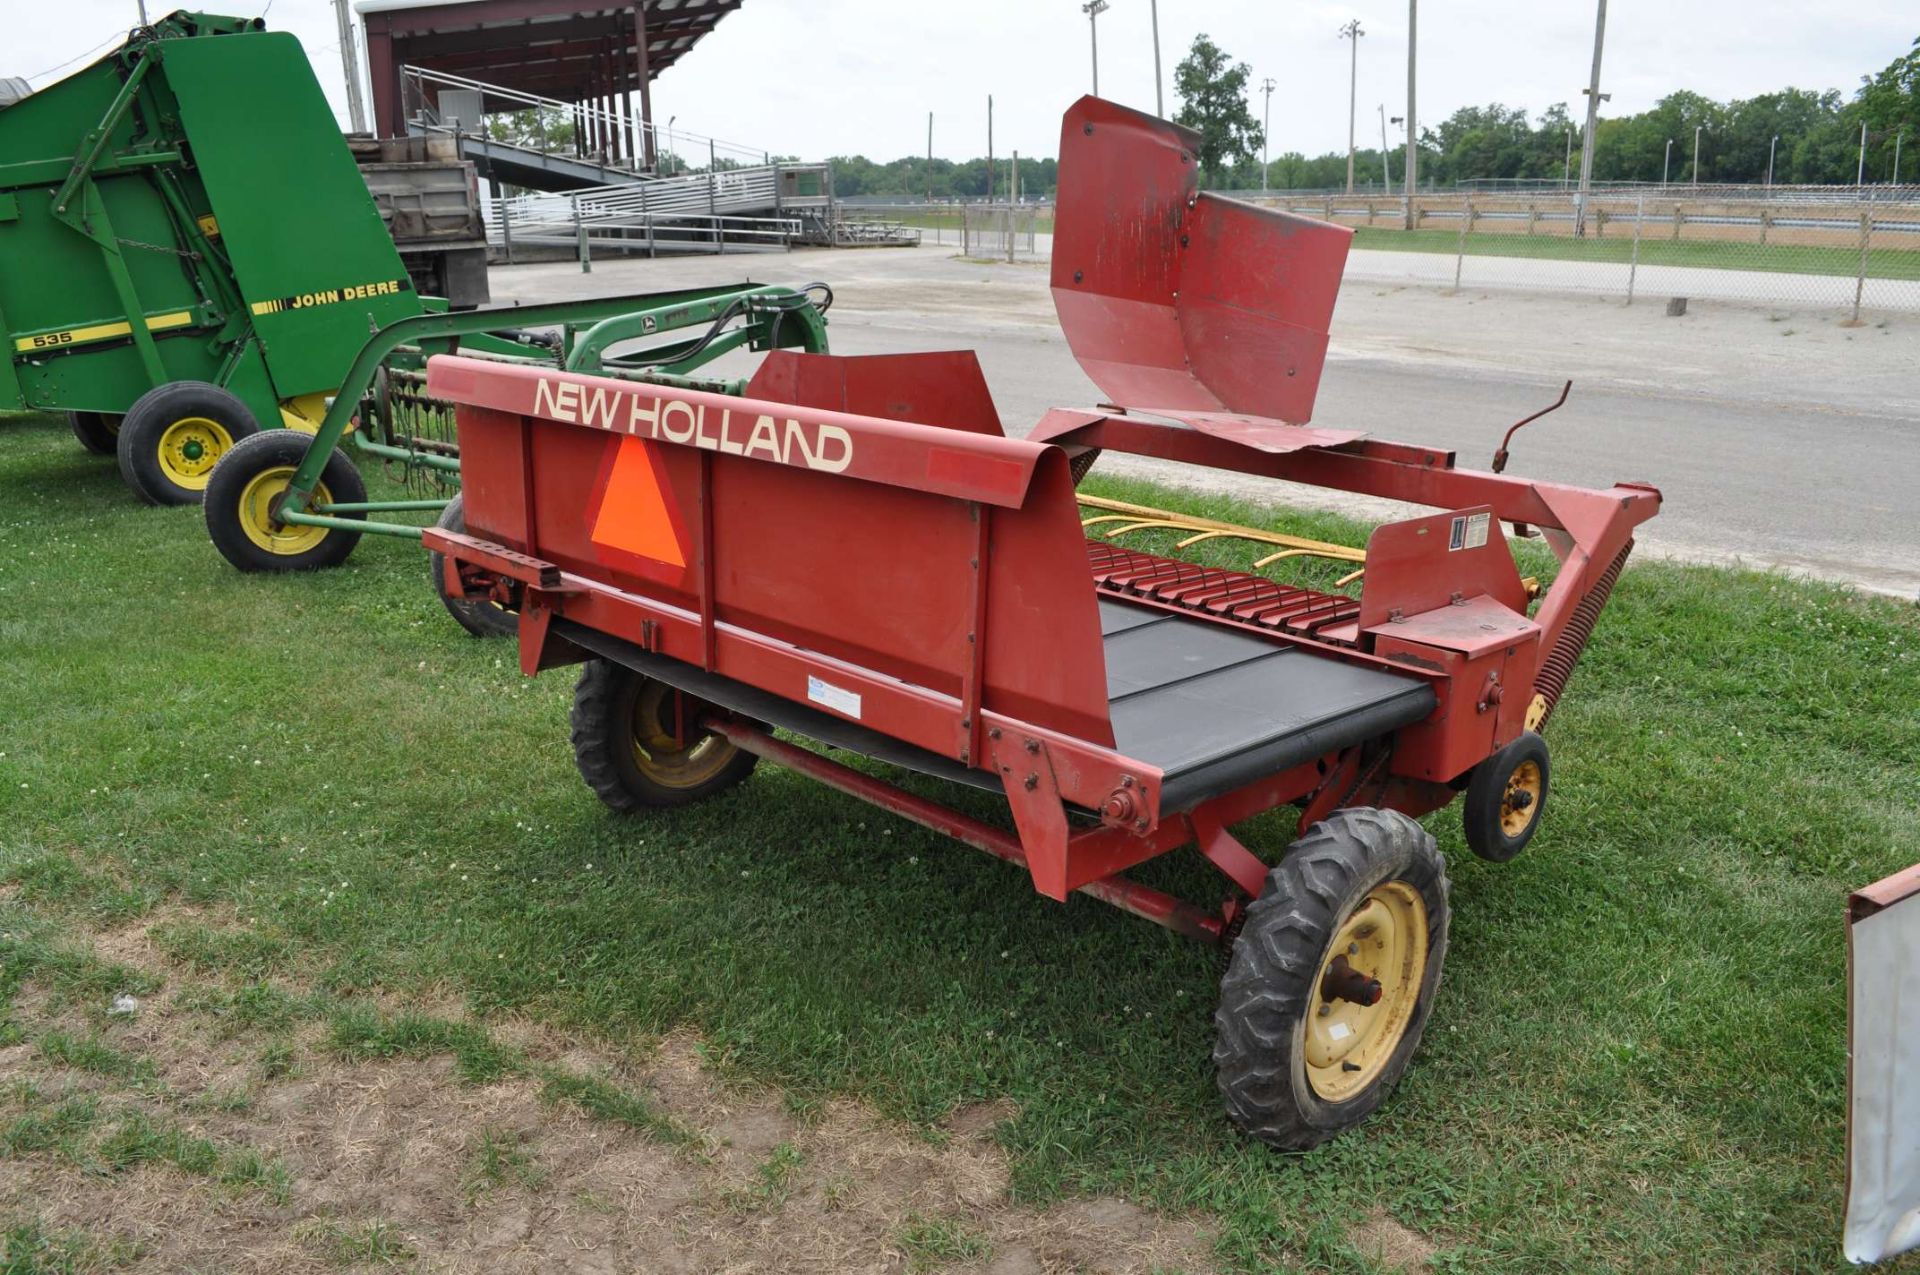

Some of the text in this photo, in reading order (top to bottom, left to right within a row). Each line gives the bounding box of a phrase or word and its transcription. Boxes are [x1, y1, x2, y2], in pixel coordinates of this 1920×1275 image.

[292, 280, 400, 309] JOHN DEERE
[33, 332, 72, 347] 535
[533, 377, 854, 473] NEW HOLLAND
